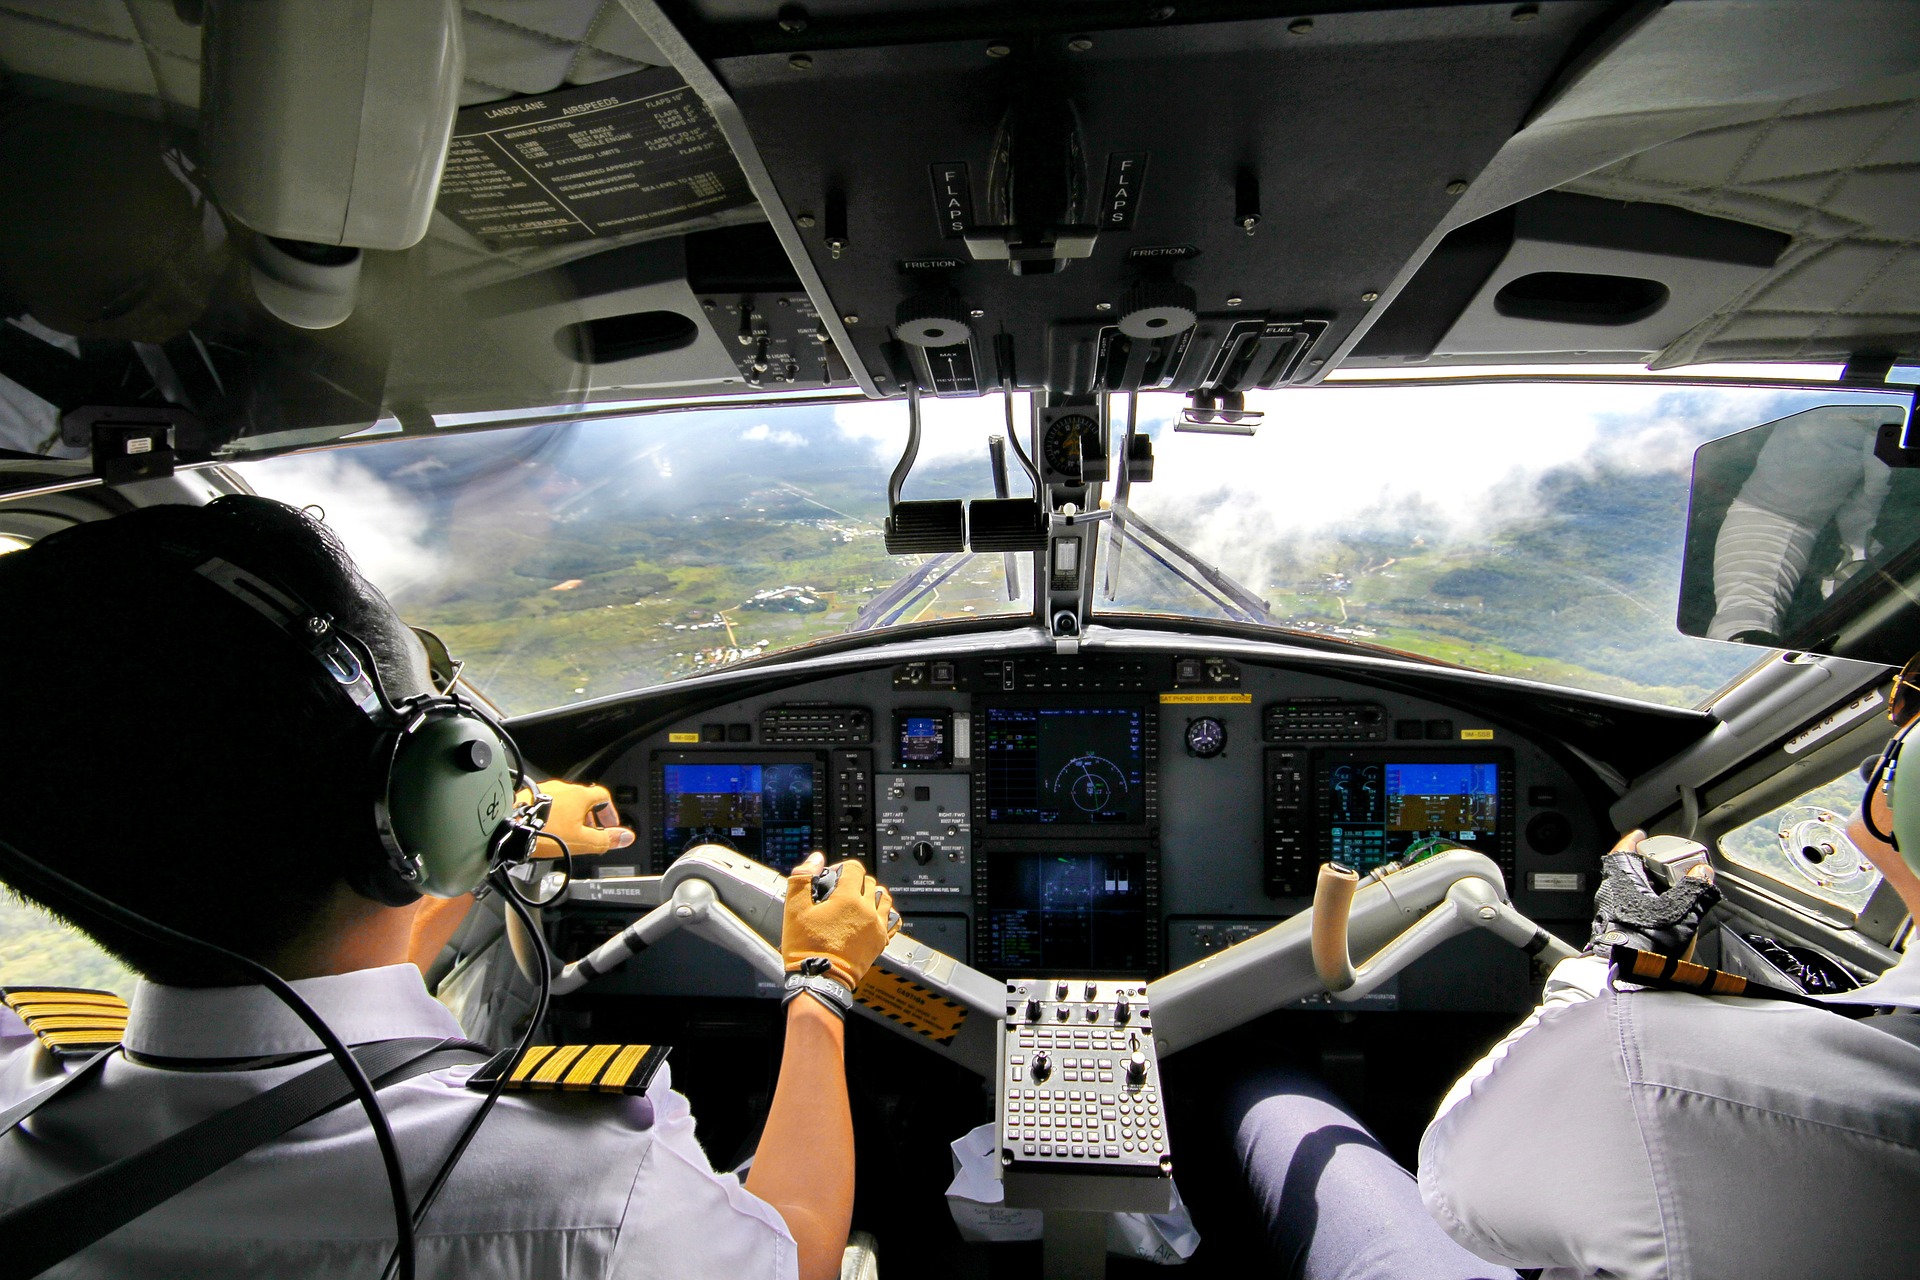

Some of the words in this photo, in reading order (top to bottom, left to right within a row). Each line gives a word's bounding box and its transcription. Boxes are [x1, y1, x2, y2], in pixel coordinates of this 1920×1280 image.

[485, 100, 547, 118] LANDPLANE
[563, 96, 619, 115] AIRSPEEDS
[504, 128, 538, 139] MINIMUM
[538, 121, 575, 133] CONTROL
[646, 98, 671, 108] FLAPS
[568, 130, 587, 139] BEST
[590, 124, 616, 134] ANGLE
[654, 108, 679, 119] FLAPS
[573, 136, 592, 144] BEST
[594, 132, 614, 140] RATE
[658, 114, 682, 125] FLAPS
[662, 119, 686, 130] FLAPS
[556, 154, 595, 166] EXTENDED
[596, 148, 621, 157] LIMITS
[551, 168, 605, 182] RECOMMENDED
[606, 160, 644, 172] APPROACH
[945, 171, 964, 231] FLAPS
[1111, 160, 1134, 222] FLAPS
[1133, 246, 1186, 257] FRICTION
[904, 260, 956, 269] FRICTION
[1788, 716, 1834, 746] STEP
[825, 982, 844, 998] 5.11
[896, 988, 925, 1005] CAUTION
